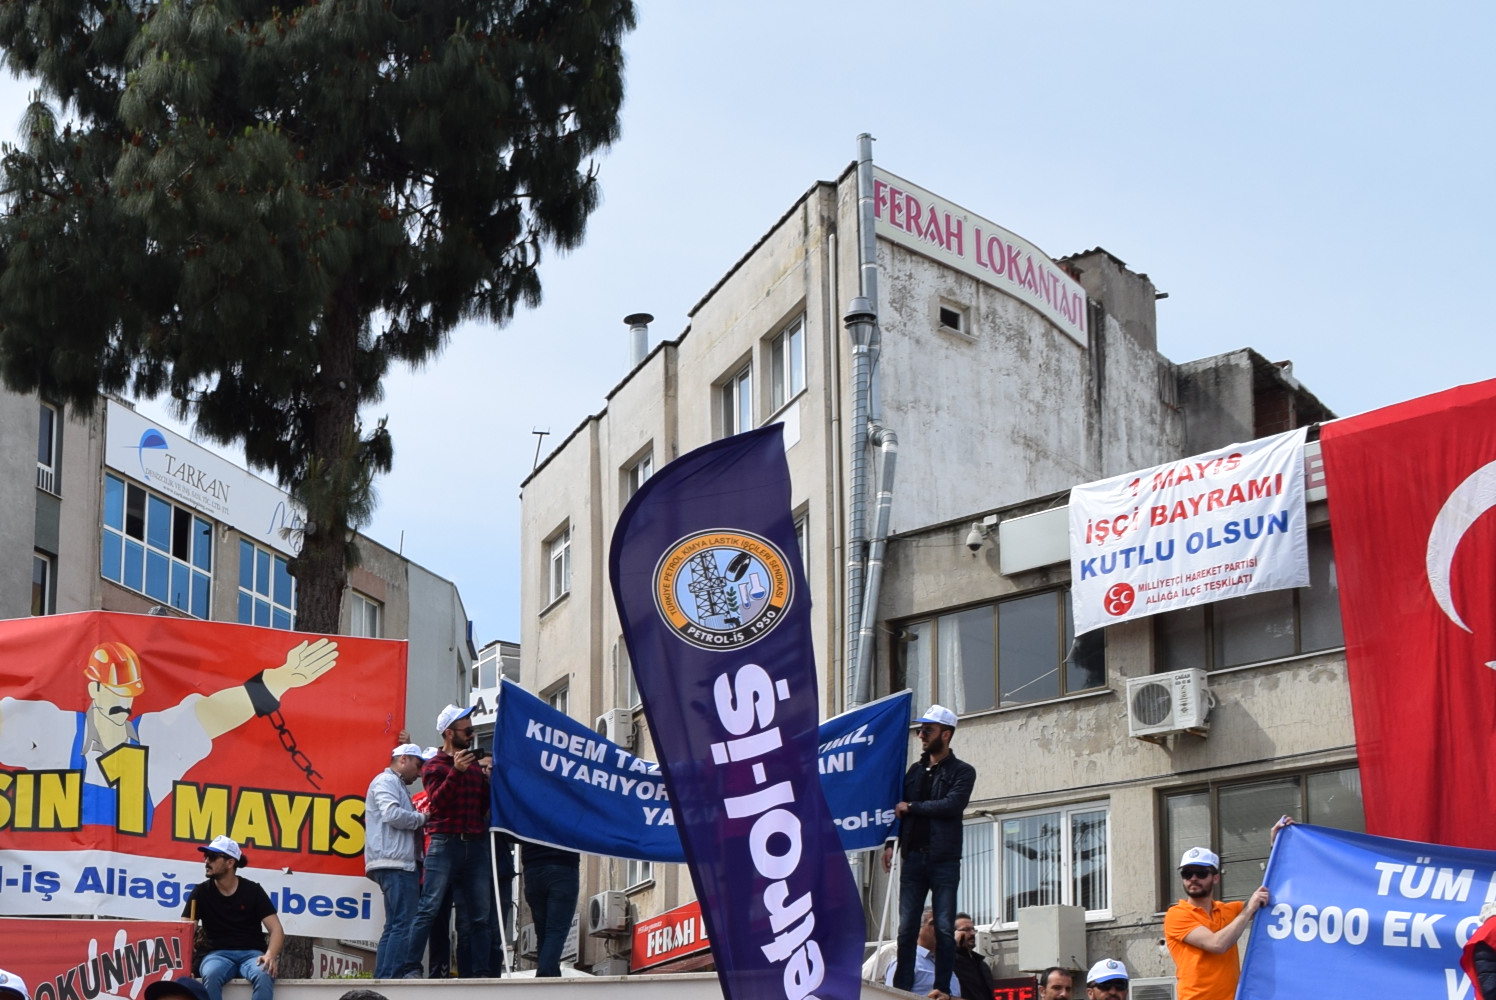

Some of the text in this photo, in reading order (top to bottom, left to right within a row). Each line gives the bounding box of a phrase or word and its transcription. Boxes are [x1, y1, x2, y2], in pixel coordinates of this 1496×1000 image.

[874, 179, 1085, 333] FERAH LOKANTASI
[165, 453, 231, 503] TARKAN
[1151, 452, 1244, 492] MAYIS
[1085, 506, 1139, 546] İŞÇİ
[1150, 472, 1283, 528] BAYRAMI
[664, 555, 684, 582] PETROL
[682, 539, 707, 555] KİMYA
[709, 537, 739, 546] LASTİK
[1080, 510, 1289, 581] KUTLU OLSUN
[1138, 555, 1258, 593] MİLLİYETÇİ HAREKET PARTİSİ
[1145, 574, 1253, 605] ALİAĞA İLÇE TEŞKİLATI
[687, 610, 777, 644] PETROL-İŞ 1950
[525, 718, 606, 764] KIDEM
[540, 750, 670, 801] UYARIYOR
[96, 743, 149, 837] 1
[172, 779, 366, 859] MAYIS
[1375, 856, 1475, 902] TÜM
[646, 916, 696, 959] FERAH
[1266, 903, 1369, 945] 3600
[1383, 910, 1447, 949] EK
